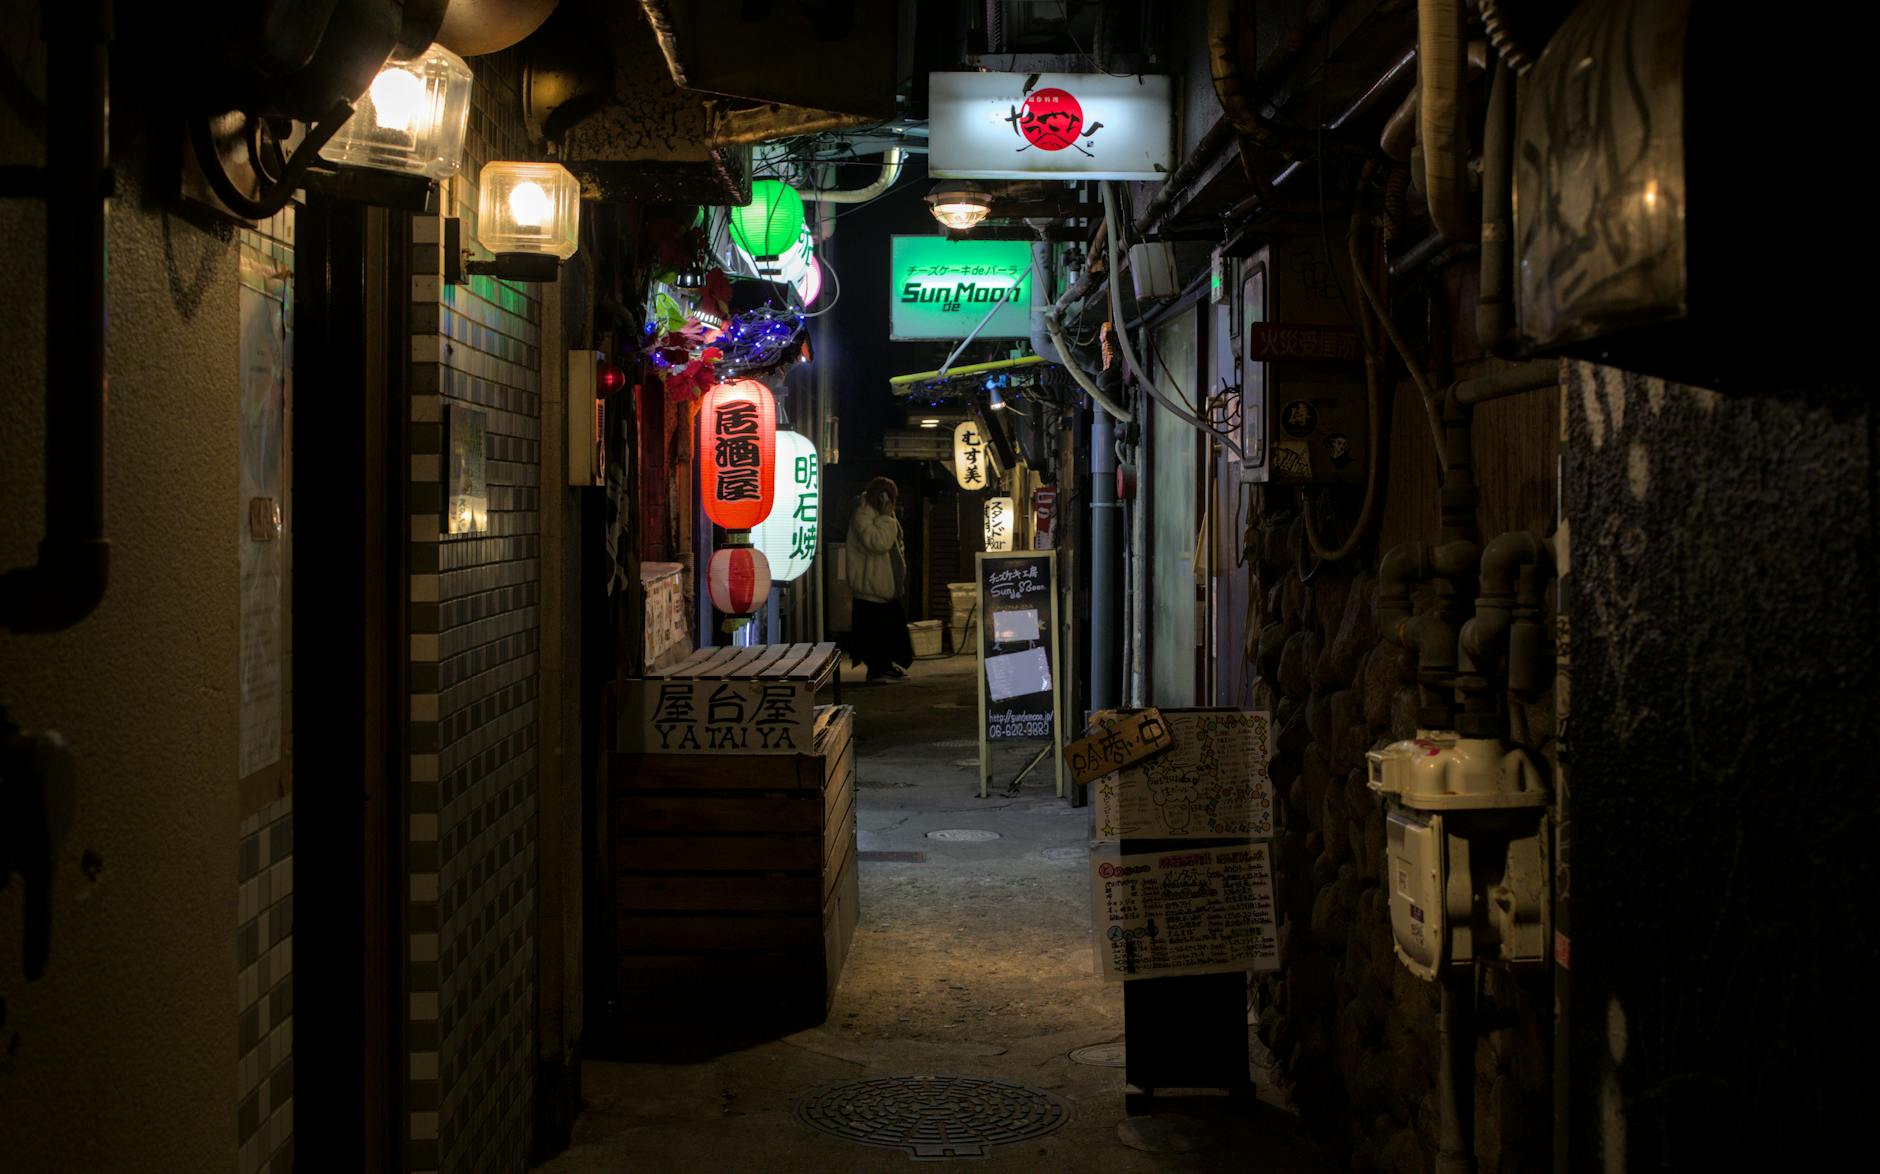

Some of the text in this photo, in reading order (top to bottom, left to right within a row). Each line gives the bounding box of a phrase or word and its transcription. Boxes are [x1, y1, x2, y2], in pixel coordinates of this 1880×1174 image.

[901, 283, 1021, 303] Sun Moon
[942, 300, 961, 312] de
[715, 401, 761, 500] 居酒屋
[962, 430, 982, 483] むす美
[789, 453, 818, 560] 明石焼
[991, 582, 1014, 598] Sun
[651, 684, 801, 726] 屋台屋
